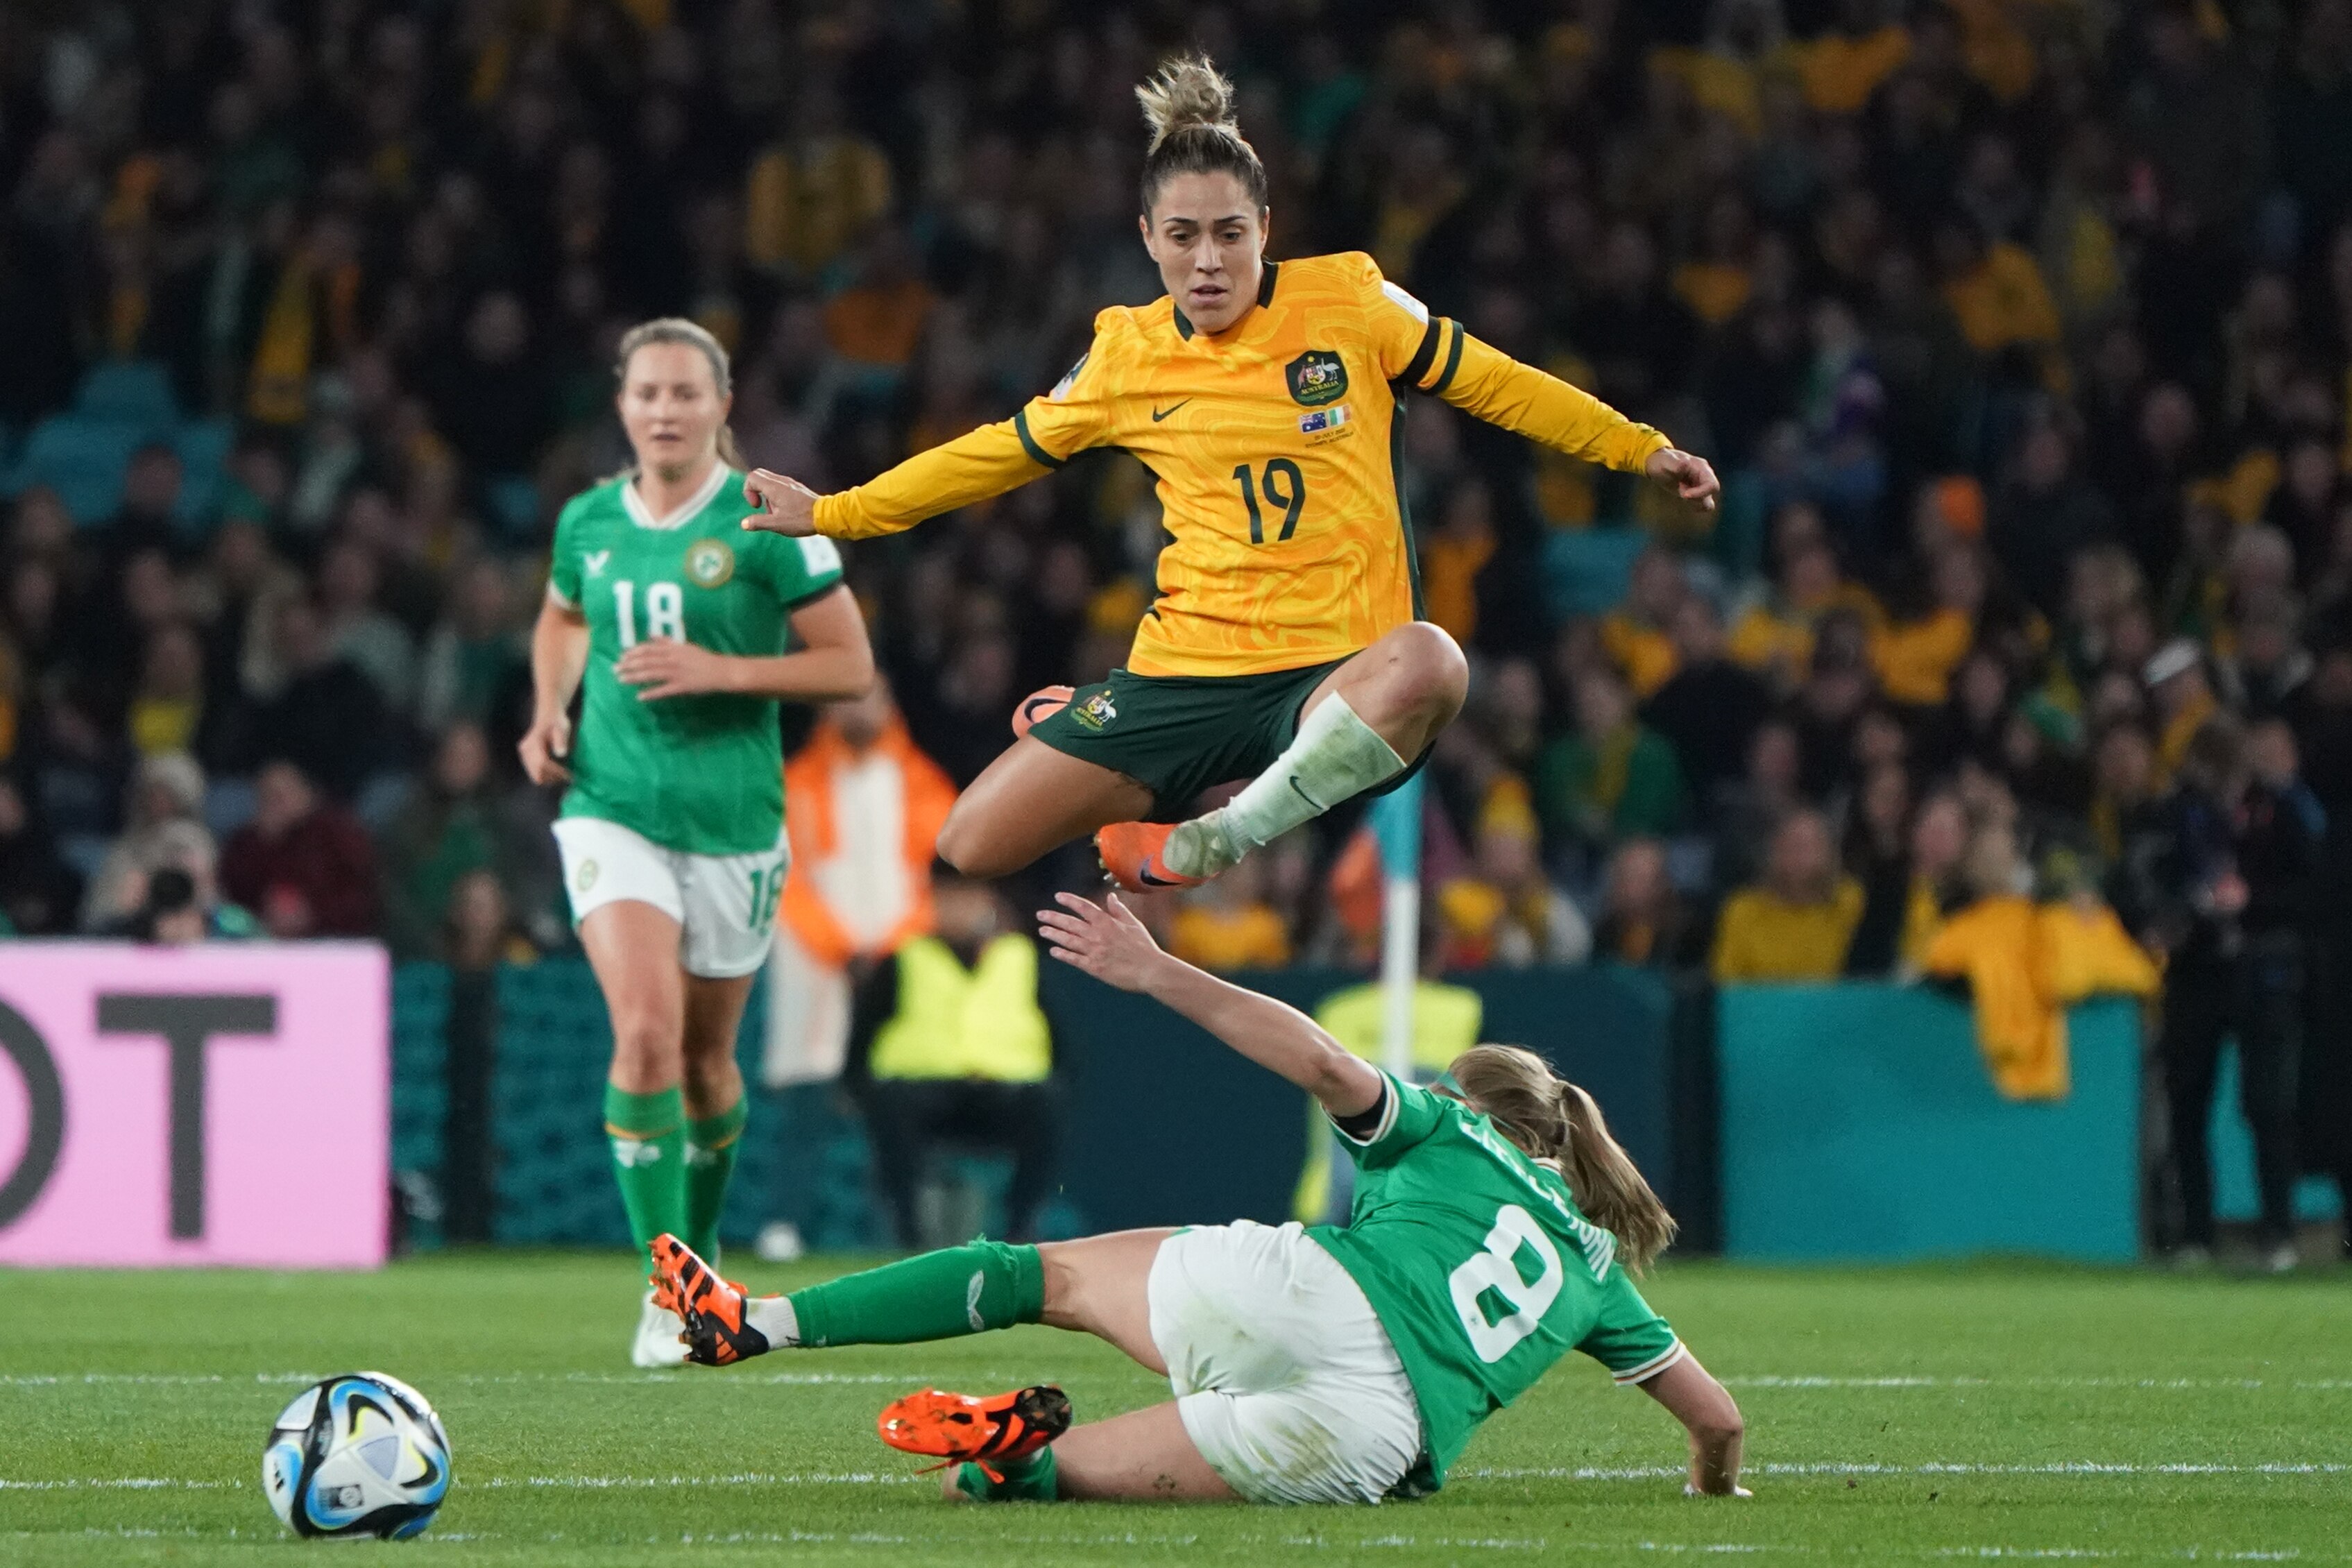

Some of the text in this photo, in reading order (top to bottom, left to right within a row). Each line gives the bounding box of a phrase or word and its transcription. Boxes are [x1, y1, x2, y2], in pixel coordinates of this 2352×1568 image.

[1301, 380, 1339, 395] AUSTRALIA
[1232, 458, 1306, 544] 19
[613, 581, 686, 648] 18
[1449, 1204, 1564, 1363] 8
